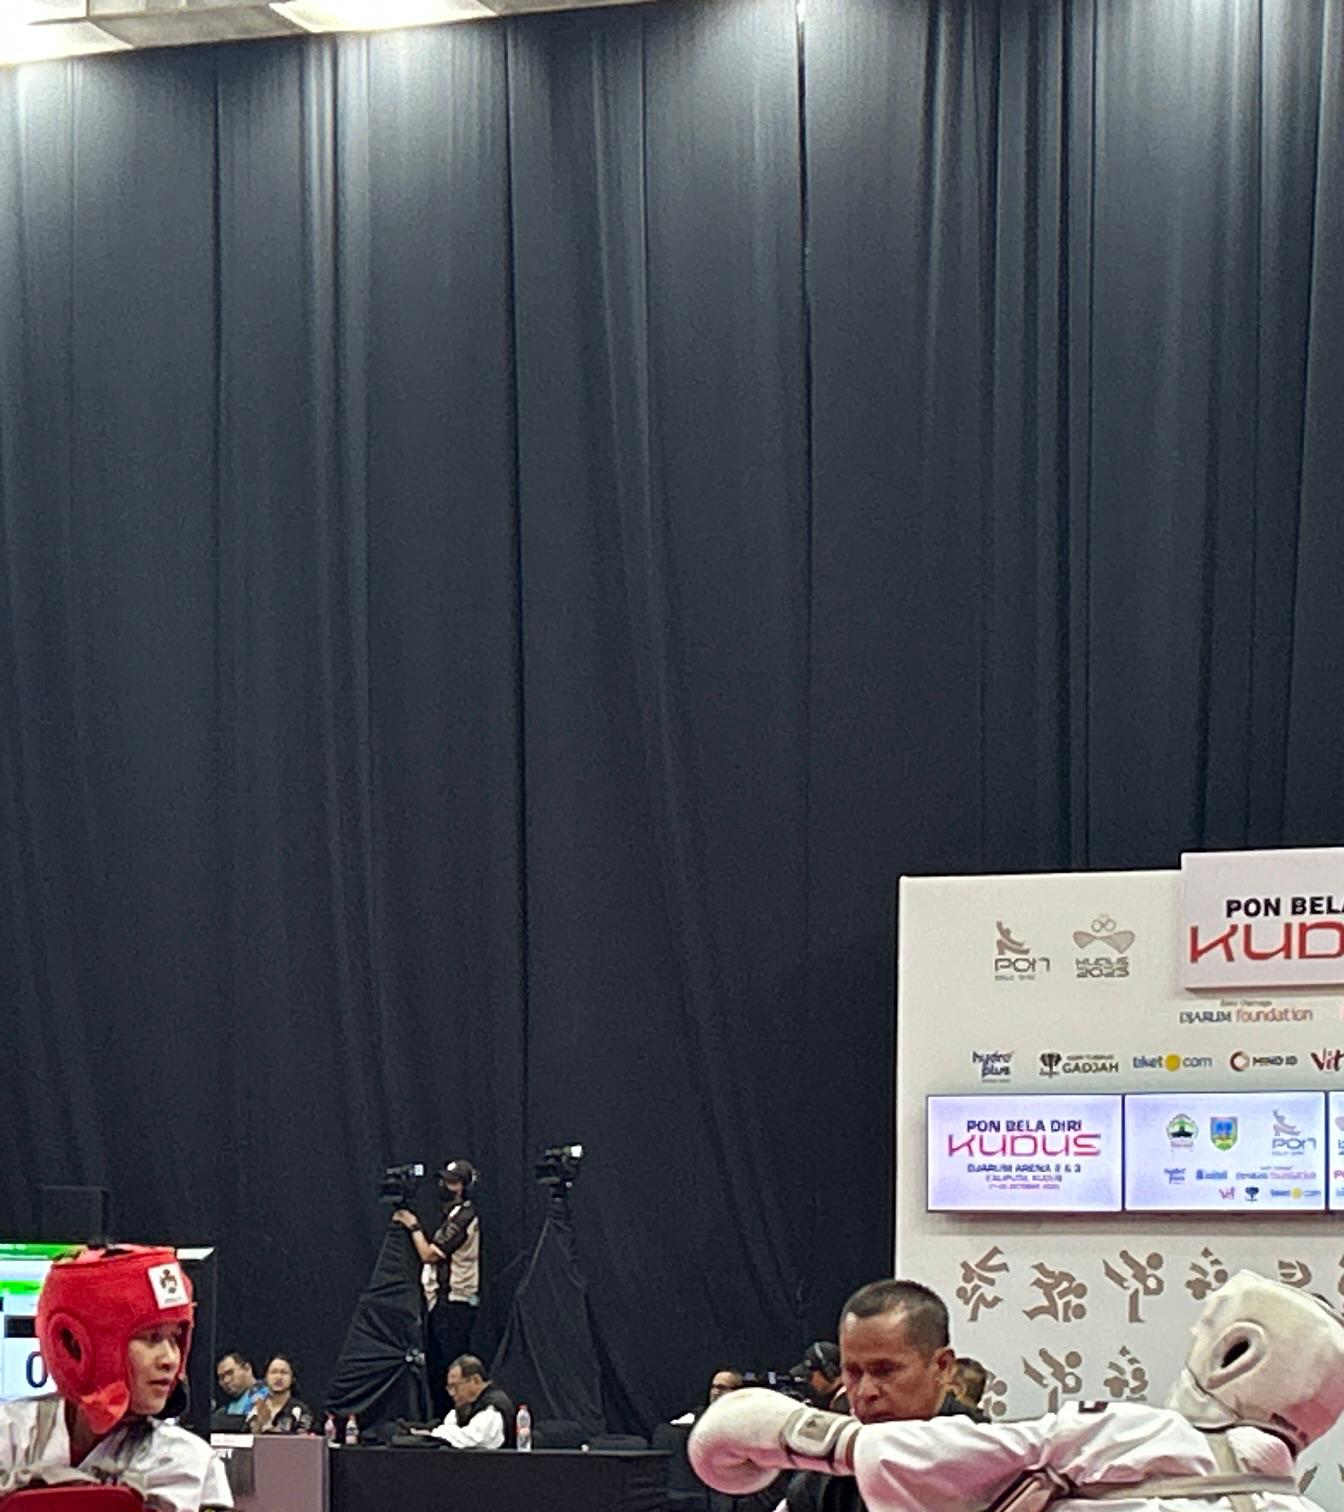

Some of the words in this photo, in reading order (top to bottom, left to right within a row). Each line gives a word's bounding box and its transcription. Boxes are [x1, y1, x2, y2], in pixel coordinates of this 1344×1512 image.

[1226, 898, 1281, 918] PON
[1236, 1005, 1313, 1023] foundation
[1062, 1061, 1119, 1075] GADJAH
[967, 1120, 1001, 1133] PON
[1005, 1120, 1046, 1132] BELA
[1050, 1119, 1083, 1132] DIRI
[948, 1134, 1102, 1157] KUDUS
